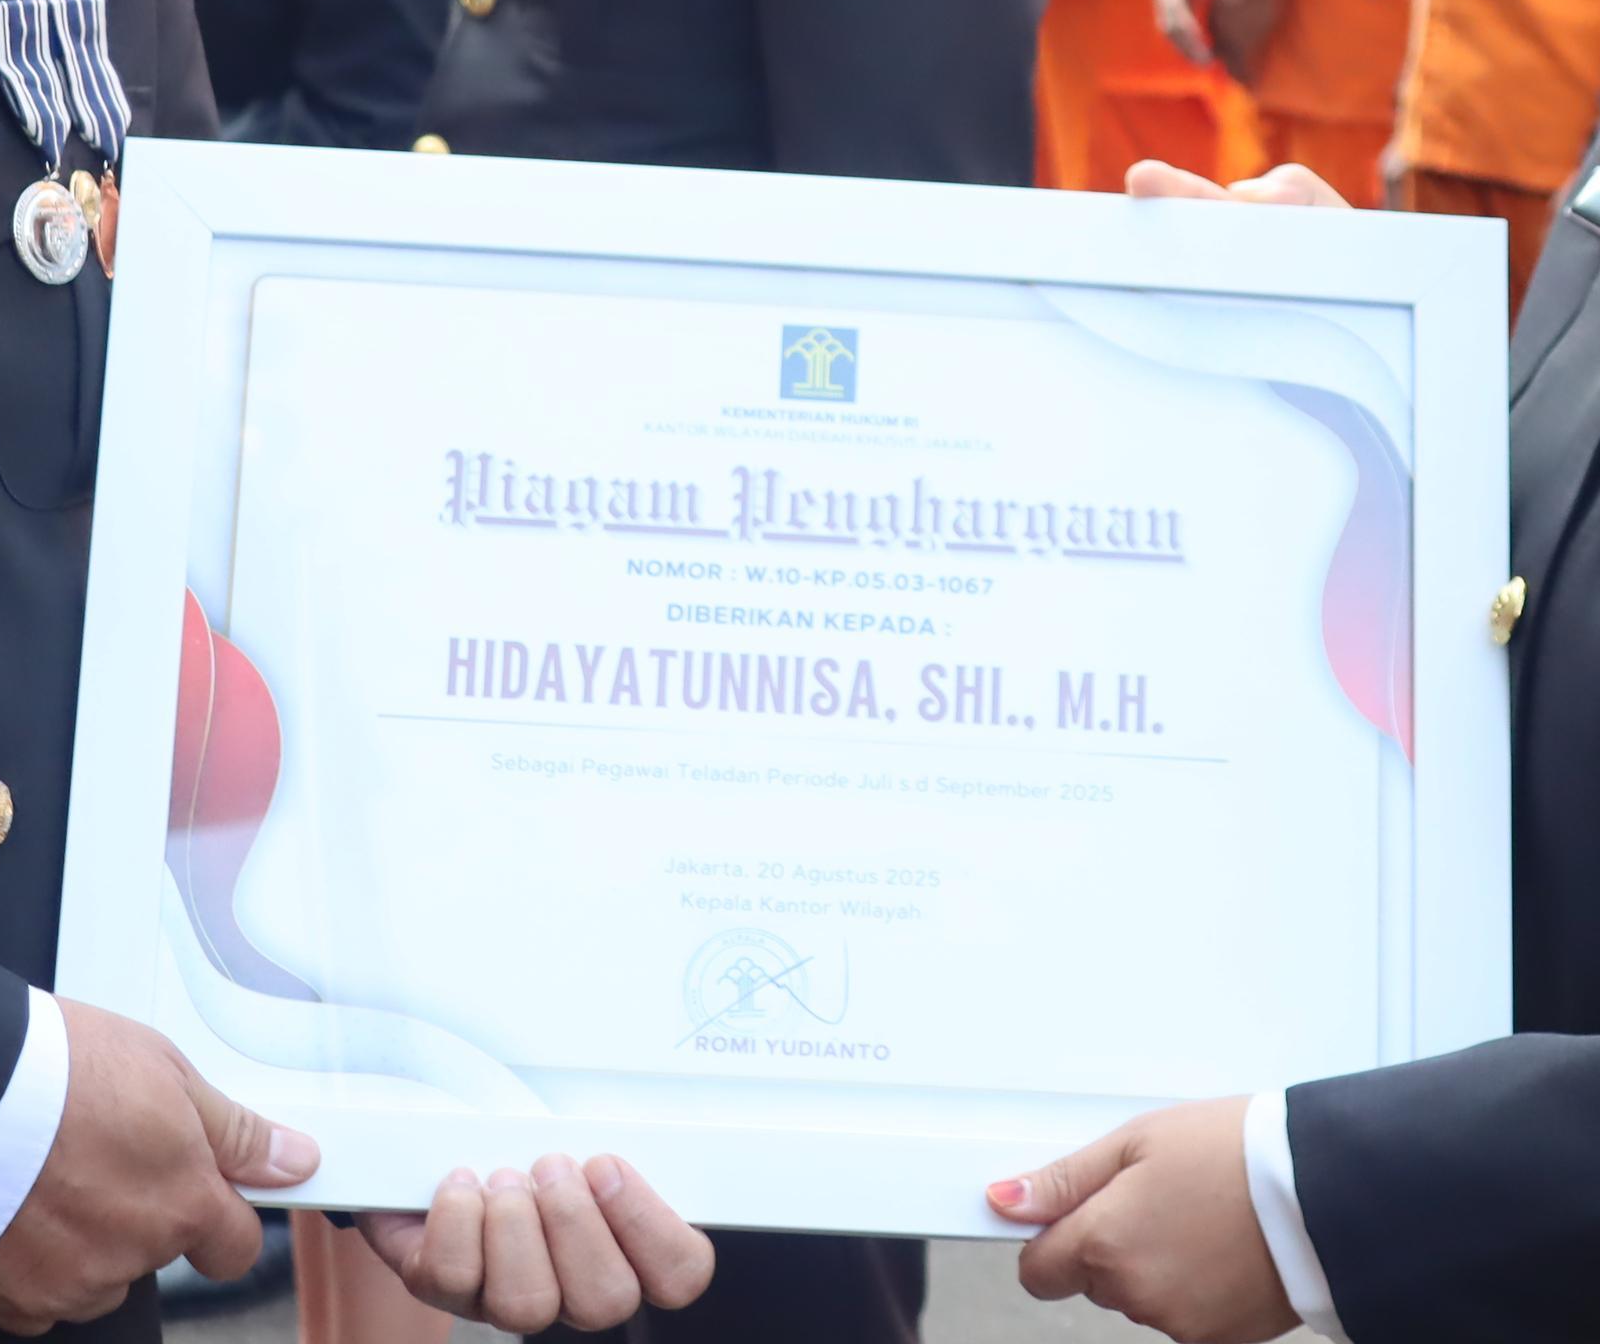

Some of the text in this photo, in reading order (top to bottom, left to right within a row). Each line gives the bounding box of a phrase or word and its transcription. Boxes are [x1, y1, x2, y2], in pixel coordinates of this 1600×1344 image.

[720, 406, 836, 424] KEMENTERIAN
[841, 412, 898, 428] HUKUM
[438, 448, 1185, 558] Piagam Penghargaan
[625, 558, 723, 581] NOMOR
[745, 565, 995, 595] W.10-KP.05.03-1067
[666, 601, 814, 630] DIBERIKAN
[824, 611, 937, 637] KEPADA
[445, 636, 1165, 736] HIDAYATUNNISA, SHI., M.H.
[490, 752, 574, 778] Sebagai
[581, 757, 669, 782] Pegawai
[677, 761, 760, 783] Teladan
[768, 767, 849, 788] Periode
[857, 770, 893, 791] Juli
[936, 775, 1050, 800] September
[1058, 783, 1115, 802] 2025
[757, 862, 785, 880] 20
[792, 865, 879, 886] Agustus
[886, 868, 941, 888] 2025
[680, 890, 921, 924] Kepala Kantor Wilayah
[695, 1036, 891, 1061] ROMI YUDIANTO
